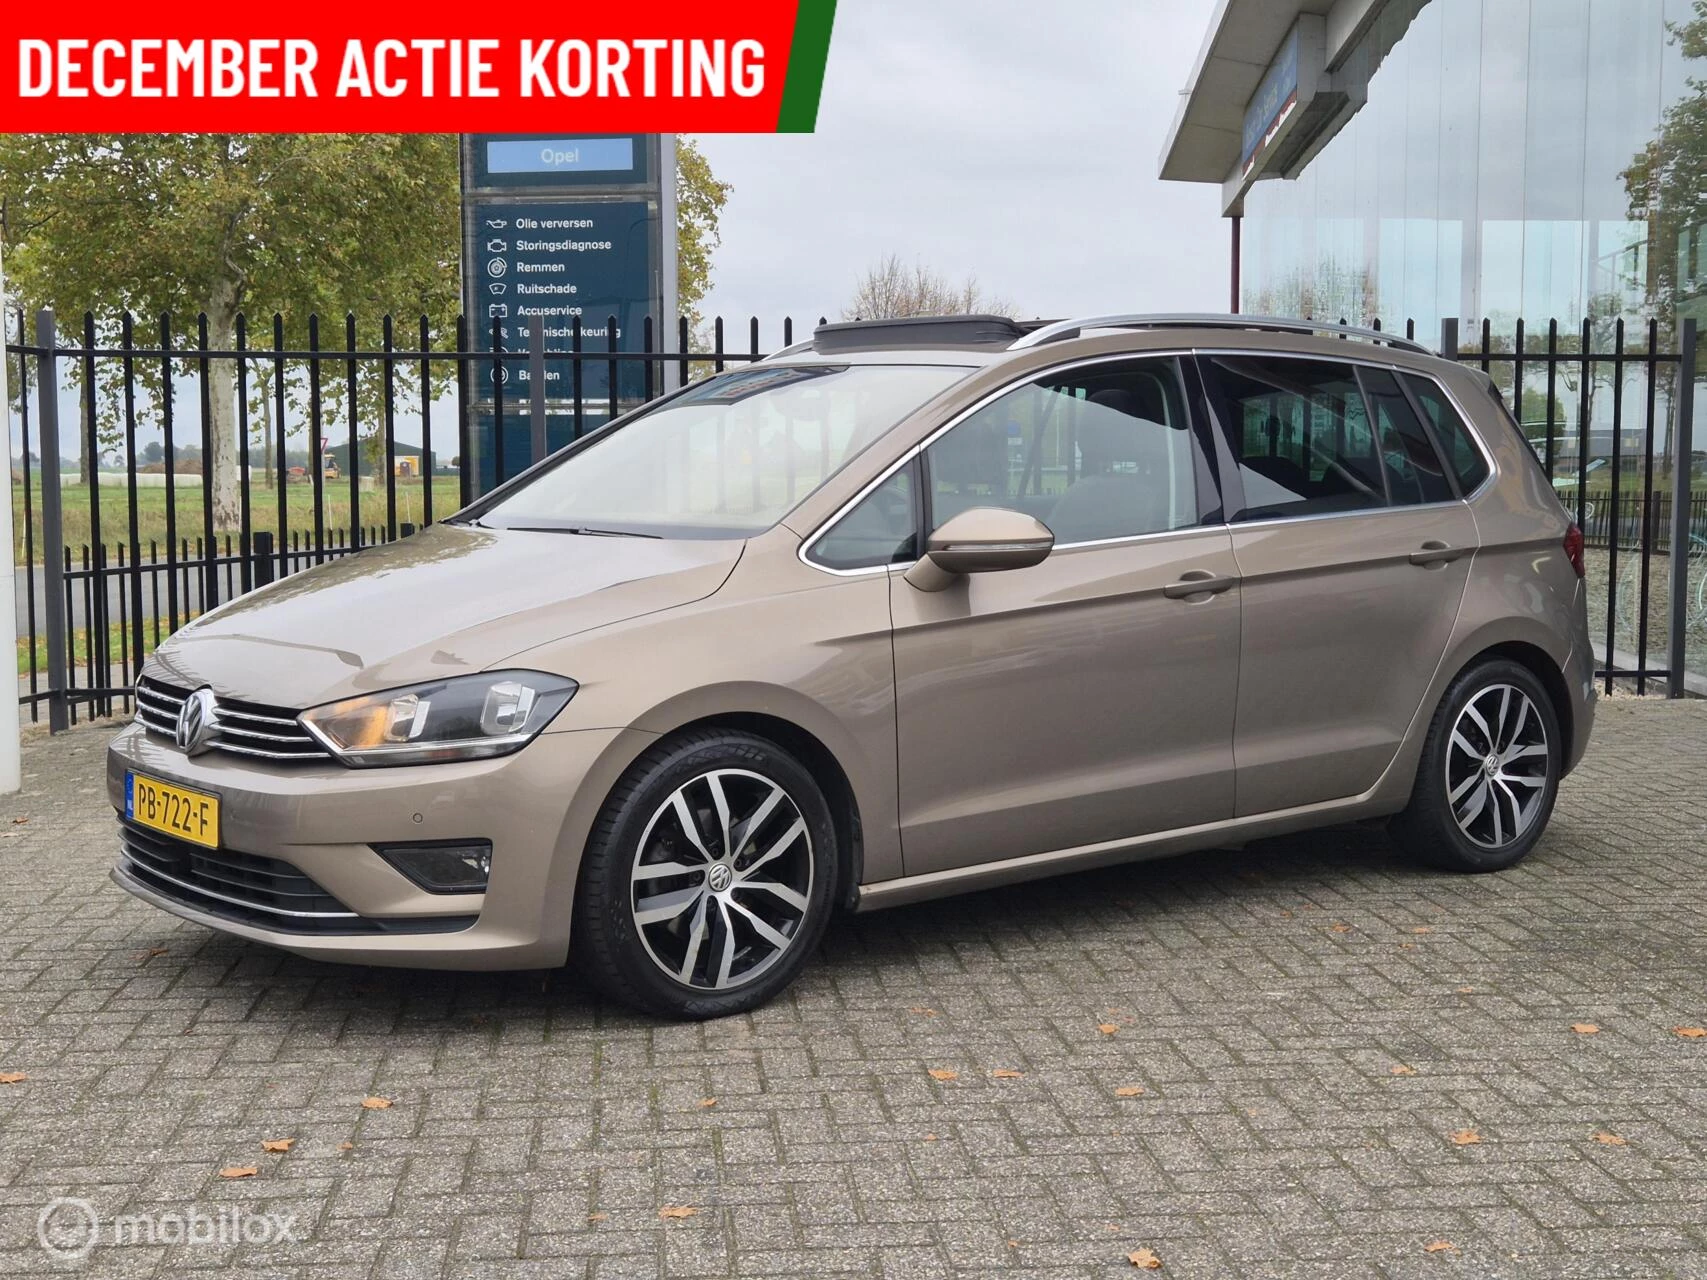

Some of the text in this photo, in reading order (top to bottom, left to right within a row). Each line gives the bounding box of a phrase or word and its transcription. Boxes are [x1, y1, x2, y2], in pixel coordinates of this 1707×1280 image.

[540, 148, 580, 165] Opel
[516, 218, 594, 229] Olie verversen
[516, 239, 612, 252] Storingsdiagnose
[516, 262, 566, 273] Remmen
[517, 283, 577, 294] Ruitschade
[517, 305, 583, 316] Accuservice
[580, 326, 622, 339] keurig
[138, 783, 209, 837] PB-722-F
